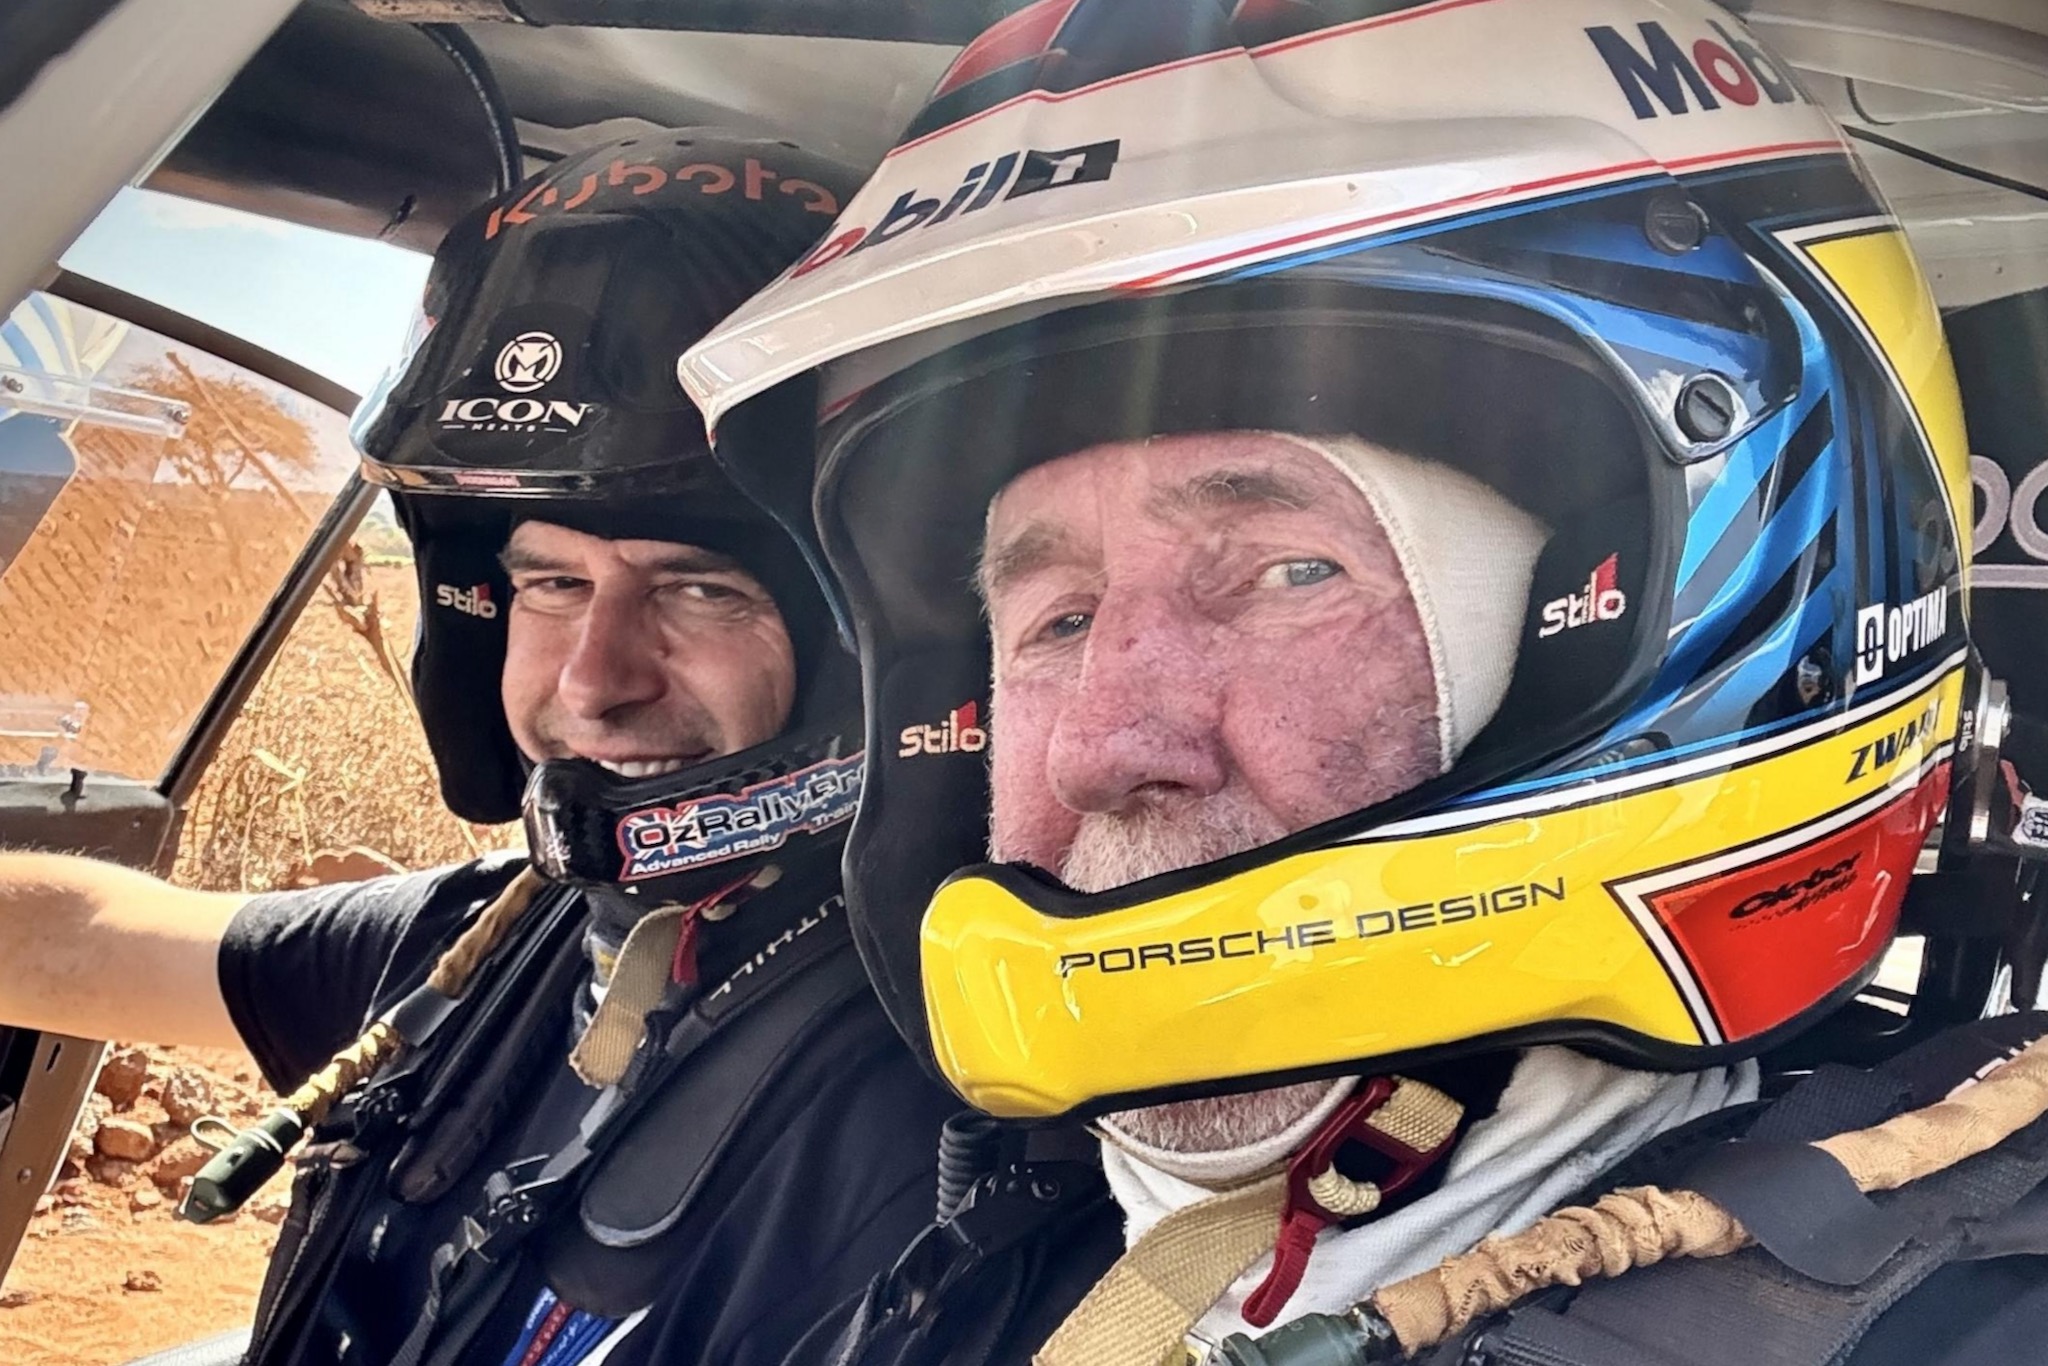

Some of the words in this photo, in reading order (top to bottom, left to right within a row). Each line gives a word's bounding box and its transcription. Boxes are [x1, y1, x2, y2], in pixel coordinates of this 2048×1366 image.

[1584, 19, 1811, 120] Mob
[485, 159, 839, 240] Kubota
[790, 151, 1021, 279] obil
[437, 398, 590, 427] ICON
[1888, 585, 1948, 662] OPTIMA
[631, 843, 731, 875] Advanced
[733, 832, 781, 852] Rally
[811, 800, 859, 826] Train
[633, 764, 867, 849] OzRallyPr
[709, 894, 845, 1001] UTHILL
[1060, 919, 1336, 978] PORSCHE
[1357, 877, 1566, 939] DESIGN
